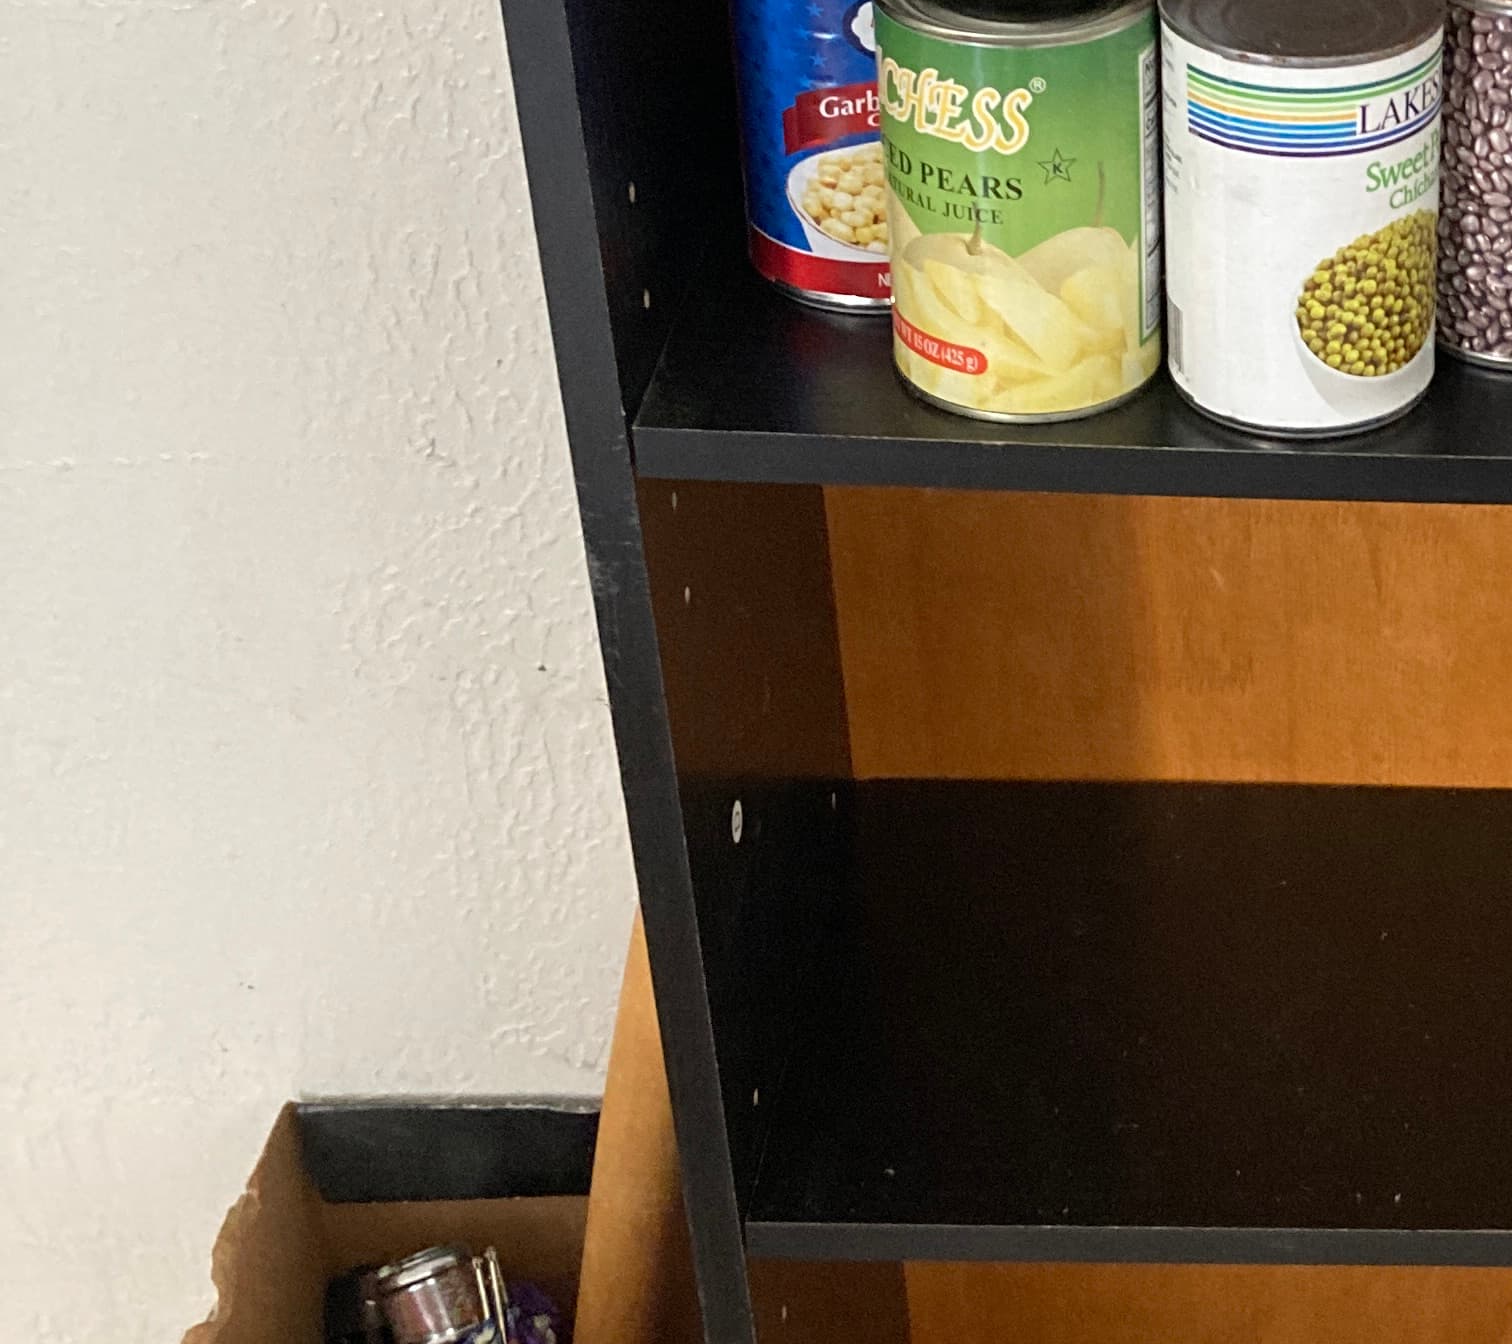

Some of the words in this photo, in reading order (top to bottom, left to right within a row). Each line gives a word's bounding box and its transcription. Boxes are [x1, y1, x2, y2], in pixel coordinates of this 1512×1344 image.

[1360, 69, 1439, 134] LAKES
[919, 160, 1023, 200] PEARS
[1366, 142, 1428, 193] Sweet
[942, 202, 1004, 224] JUICE
